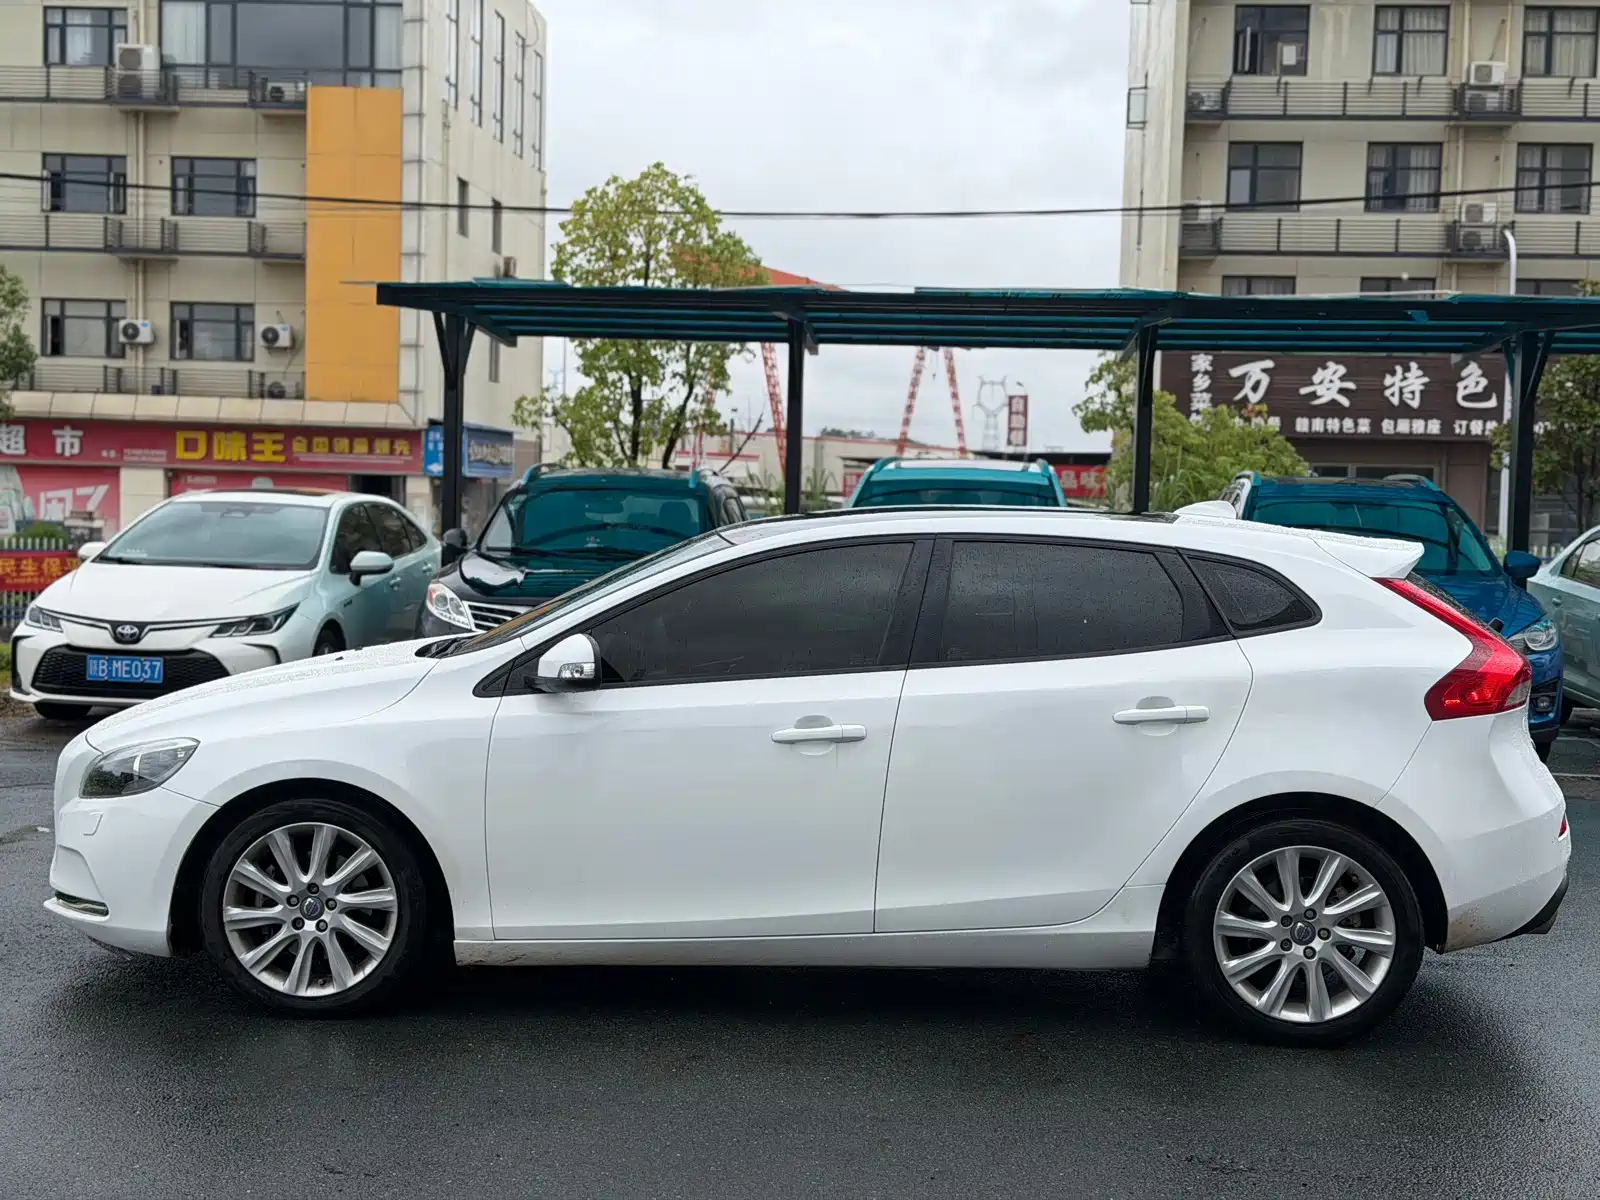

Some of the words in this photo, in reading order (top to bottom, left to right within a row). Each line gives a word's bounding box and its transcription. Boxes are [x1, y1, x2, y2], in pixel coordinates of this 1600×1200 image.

[1228, 359, 1499, 410] 万安特色
[0, 423, 85, 457] 超市
[175, 430, 286, 463] 口味王
